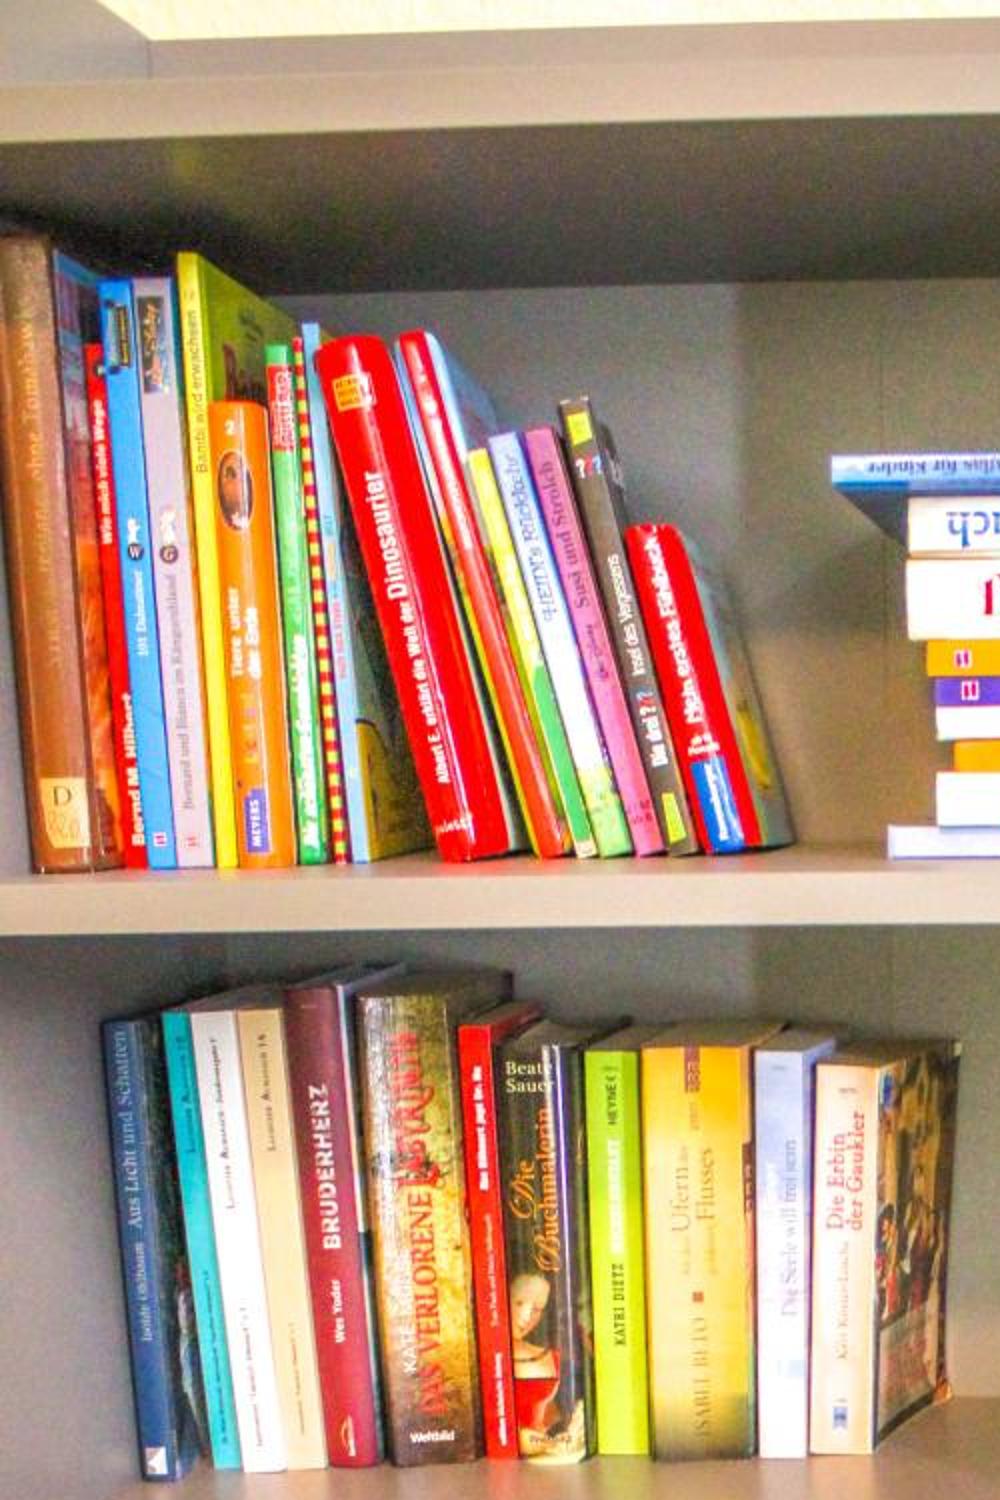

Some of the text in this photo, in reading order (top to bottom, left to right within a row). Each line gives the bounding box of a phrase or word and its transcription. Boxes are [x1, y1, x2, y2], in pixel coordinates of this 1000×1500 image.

[189, 393, 206, 423] wird
[363, 470, 408, 600] Dinosaurier
[539, 460, 589, 609] Susi und Strolch
[225, 587, 241, 630] unter
[606, 553, 646, 676] Insel des Vergessens
[404, 625, 425, 658] Welt
[667, 620, 693, 676] erstes
[412, 660, 428, 681] die
[417, 683, 438, 726] erklärt
[432, 743, 451, 784] Albert
[650, 740, 667, 767] Die
[248, 798, 263, 850] MEYERS
[112, 1030, 132, 1106] Schatten
[606, 1083, 618, 1126] HEYNE
[119, 1111, 135, 1144] und
[123, 1151, 139, 1192] Licht
[309, 1084, 342, 1250] BRUDERHERZ
[535, 1102, 562, 1275] Buchmalerin
[694, 1147, 716, 1221] Flusses
[826, 1132, 846, 1231] Die Erbin
[845, 1110, 867, 1231] der Gaukler
[509, 1158, 536, 1221] Die
[670, 1166, 690, 1233] Ufern
[780, 1176, 797, 1203] frei
[780, 1209, 797, 1239] will
[406, 1187, 441, 1361] VERLORENE
[611, 1262, 627, 1302] DIETZ
[332, 1315, 345, 1343] Wes
[612, 1307, 628, 1347] KATRI
[400, 1330, 418, 1374] KATE
[419, 1367, 448, 1414] DAS
[410, 1429, 456, 1445] Weltbild
